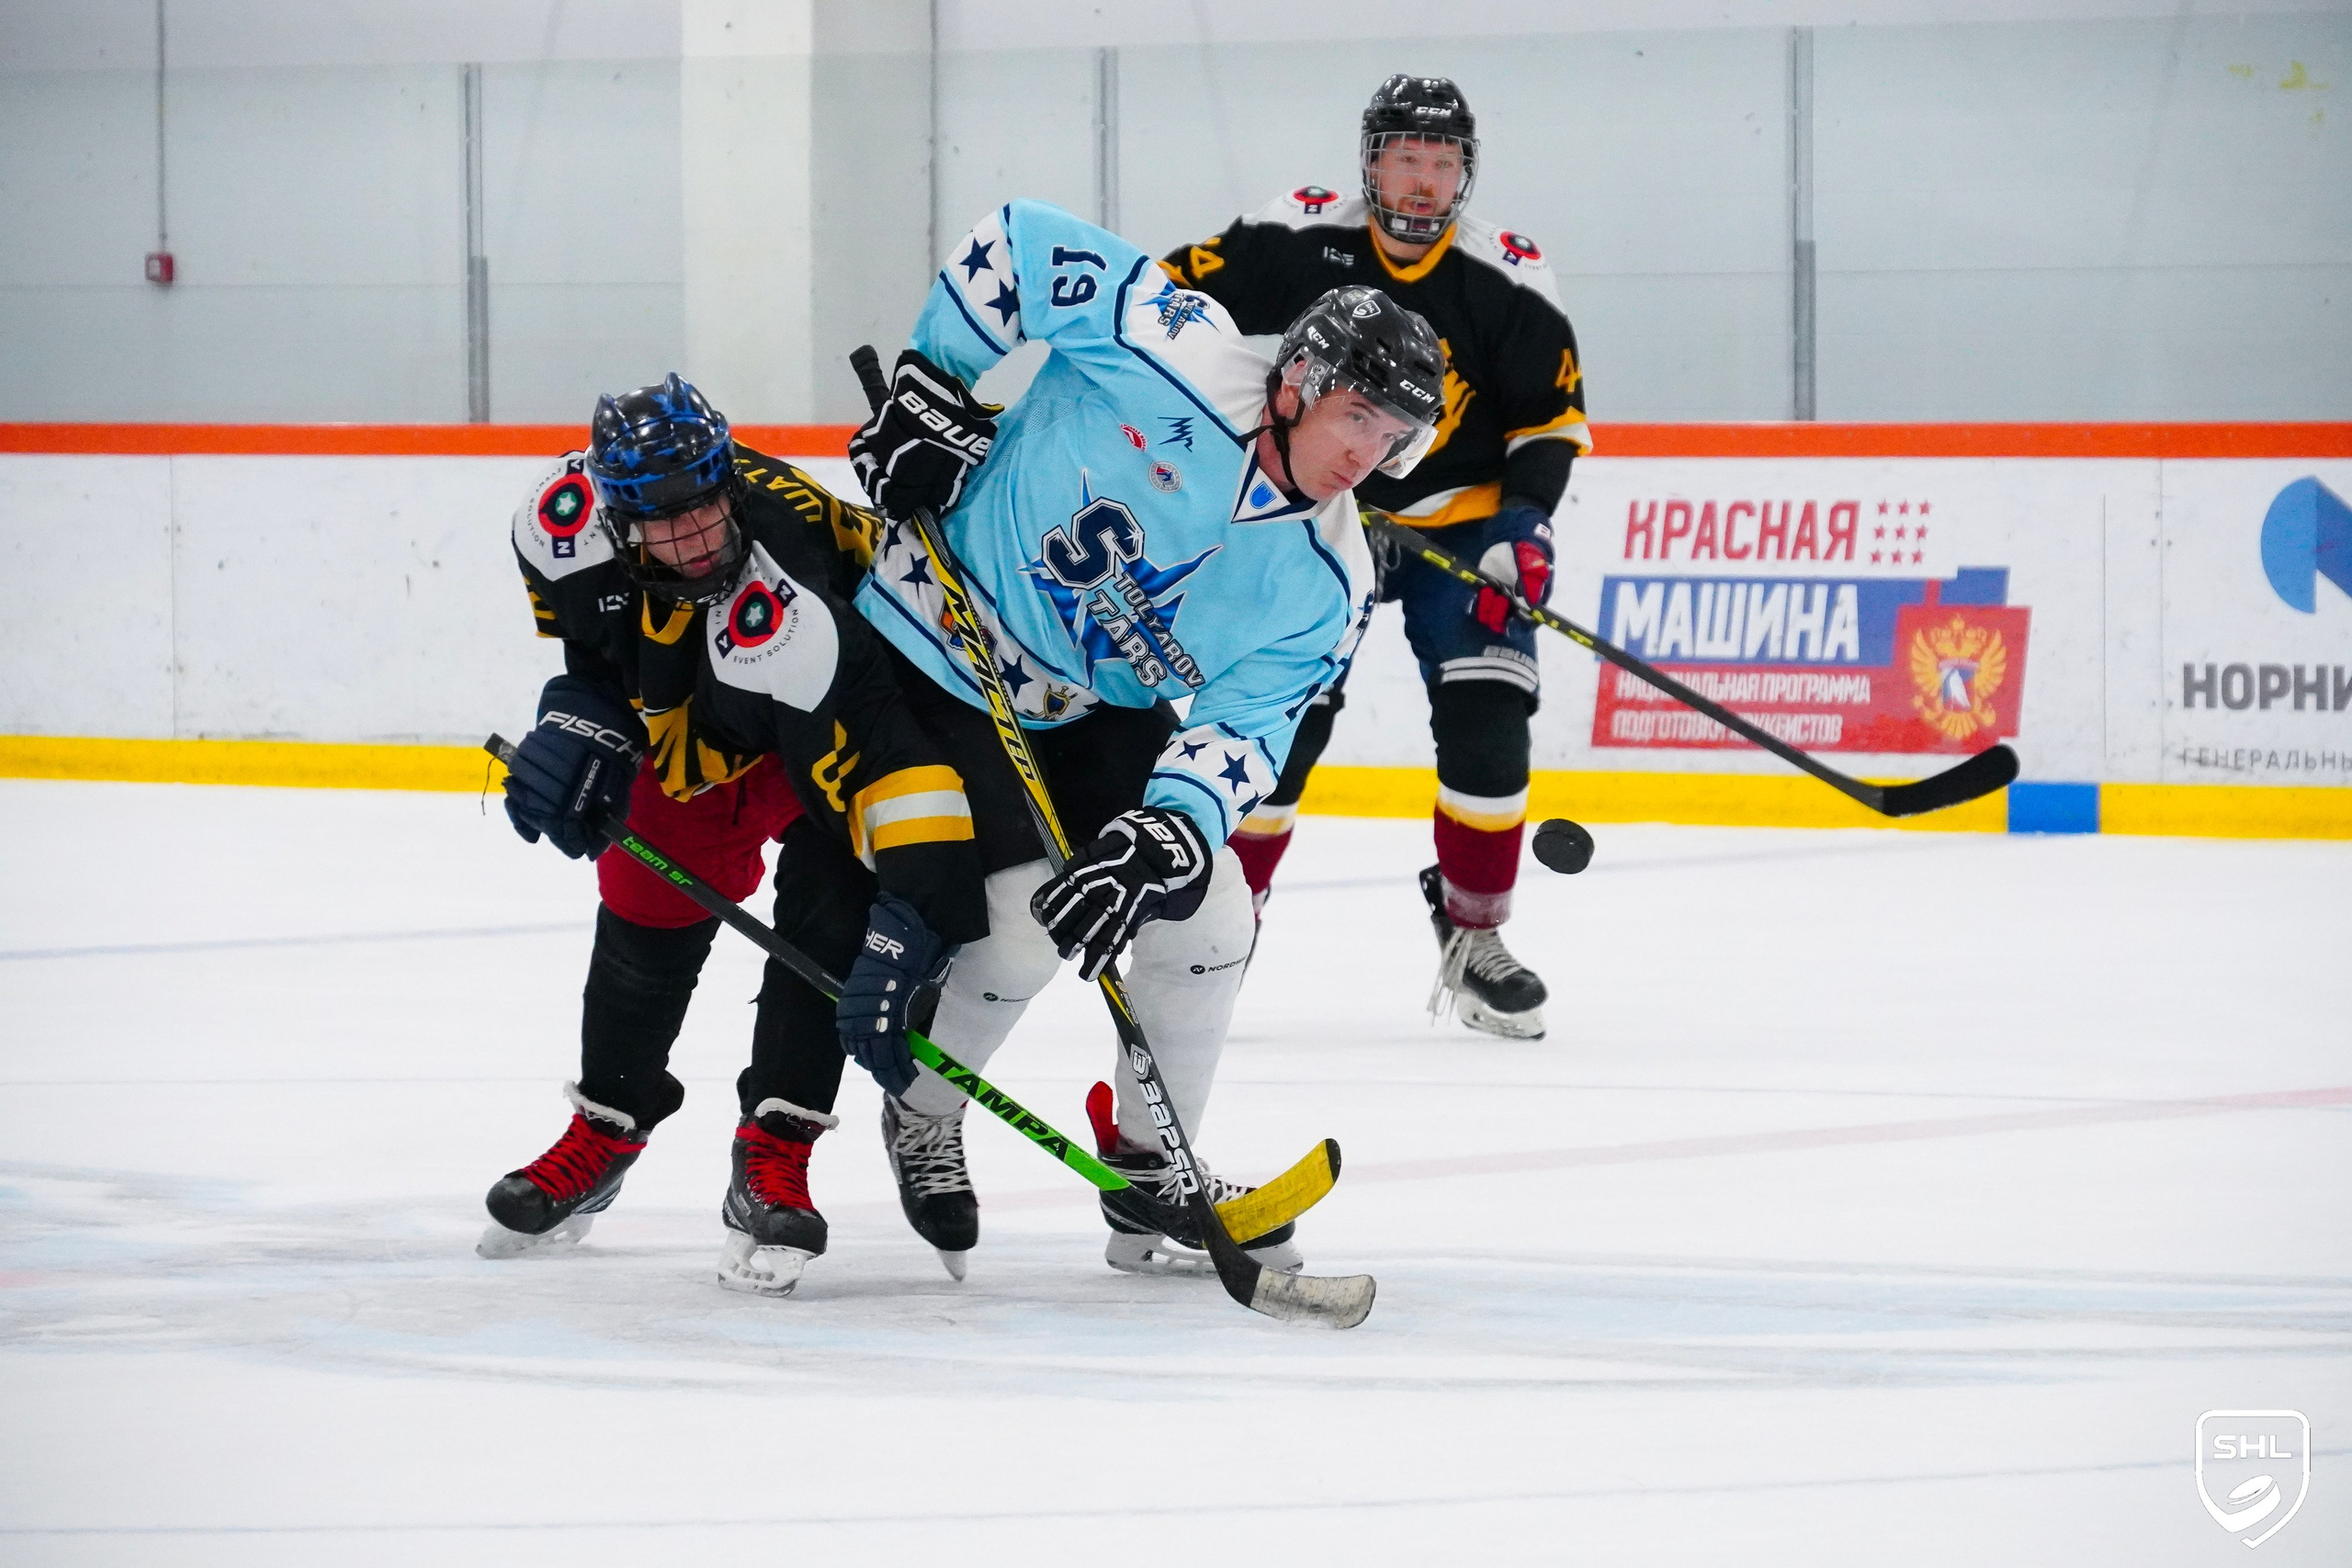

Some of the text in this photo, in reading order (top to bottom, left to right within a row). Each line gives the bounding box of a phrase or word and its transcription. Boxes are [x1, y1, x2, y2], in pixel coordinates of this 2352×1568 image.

[1415, 106, 1453, 117] CCM
[1051, 244, 1107, 308] 19
[1398, 378, 1436, 404] CCM
[1555, 347, 1582, 393] 4
[1623, 500, 1861, 562] КРАСНАЯ
[732, 608, 799, 665] EVENT SOLUTION
[1610, 581, 1860, 661] МАШИНА
[939, 580, 1037, 783] МАСТЕР
[1615, 670, 1871, 705] НАЦАЛЬНАЯ ПРОГРАММА
[1727, 712, 1844, 745] ККЕИСТОВ
[622, 836, 694, 886] team sr
[1207, 953, 1249, 973] NORD
[933, 1052, 1070, 1162] TAMPA
